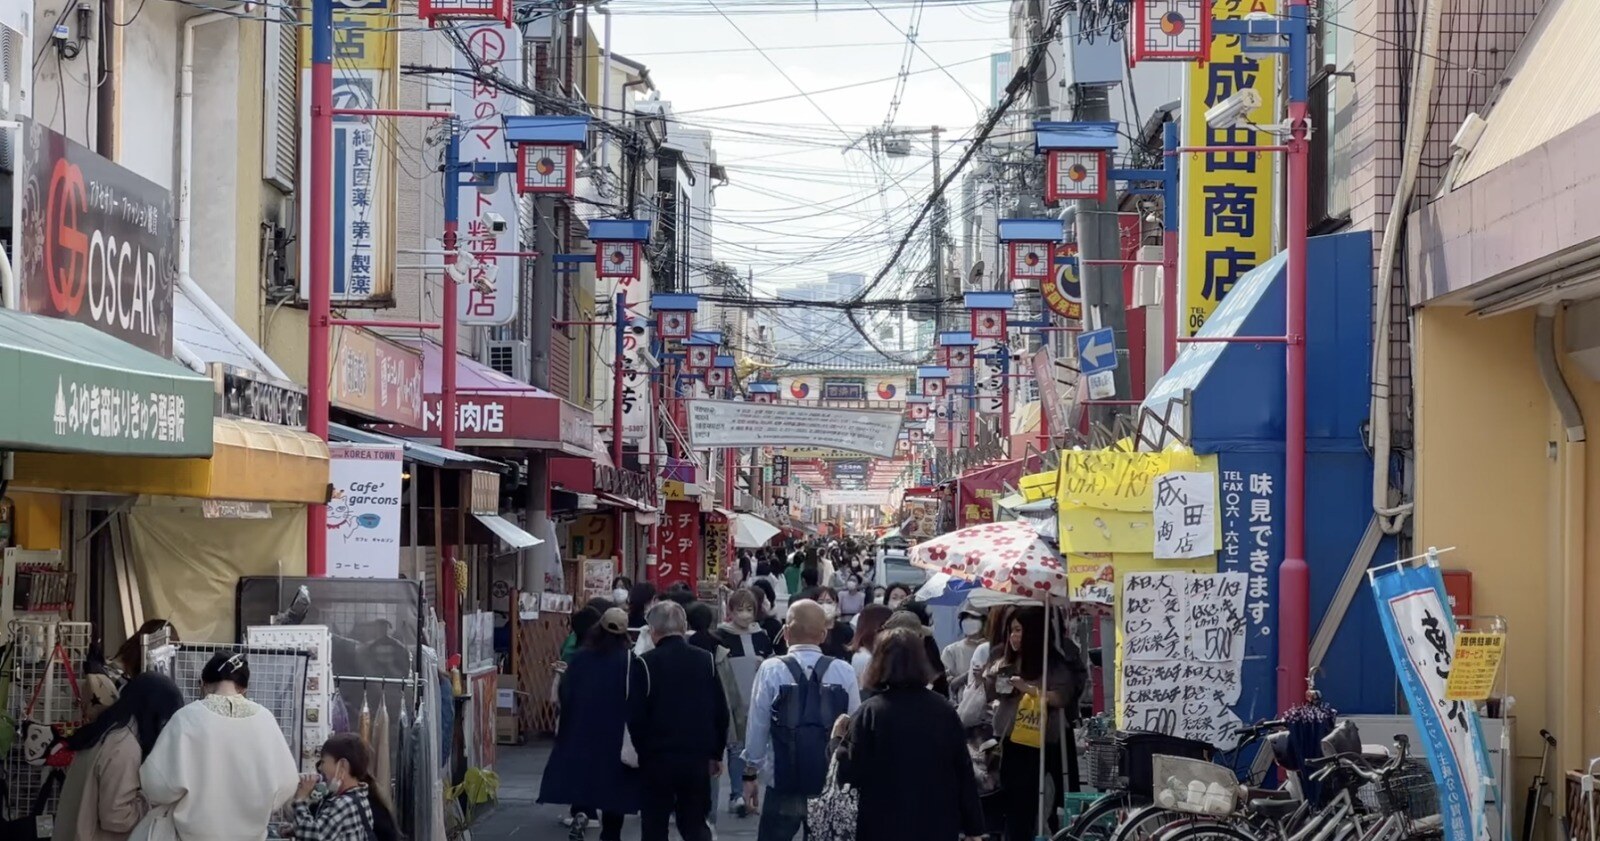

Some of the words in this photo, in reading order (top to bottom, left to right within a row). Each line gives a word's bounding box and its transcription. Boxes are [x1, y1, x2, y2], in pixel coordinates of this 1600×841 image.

[1201, 55, 1259, 302] 成田商店
[466, 74, 498, 316] 肉のマト精肉店
[88, 229, 156, 337] OSCAR
[1190, 314, 1205, 328] 06
[68, 382, 185, 442] みゆき森はりきゅう整骨院
[344, 450, 372, 459] KOREA
[374, 451, 396, 460] TOWN
[1223, 471, 1243, 481] TEL
[1223, 482, 1244, 492] FAX
[349, 495, 399, 506] garcons
[965, 504, 992, 520] 高さ
[658, 512, 674, 577] ホットク
[678, 513, 693, 577] チヂミ
[1248, 472, 1274, 637] 味見できます。
[1125, 618, 1153, 635] にら
[1204, 626, 1233, 660] 500
[1144, 707, 1177, 737] 500
[1182, 701, 1208, 716] にら
